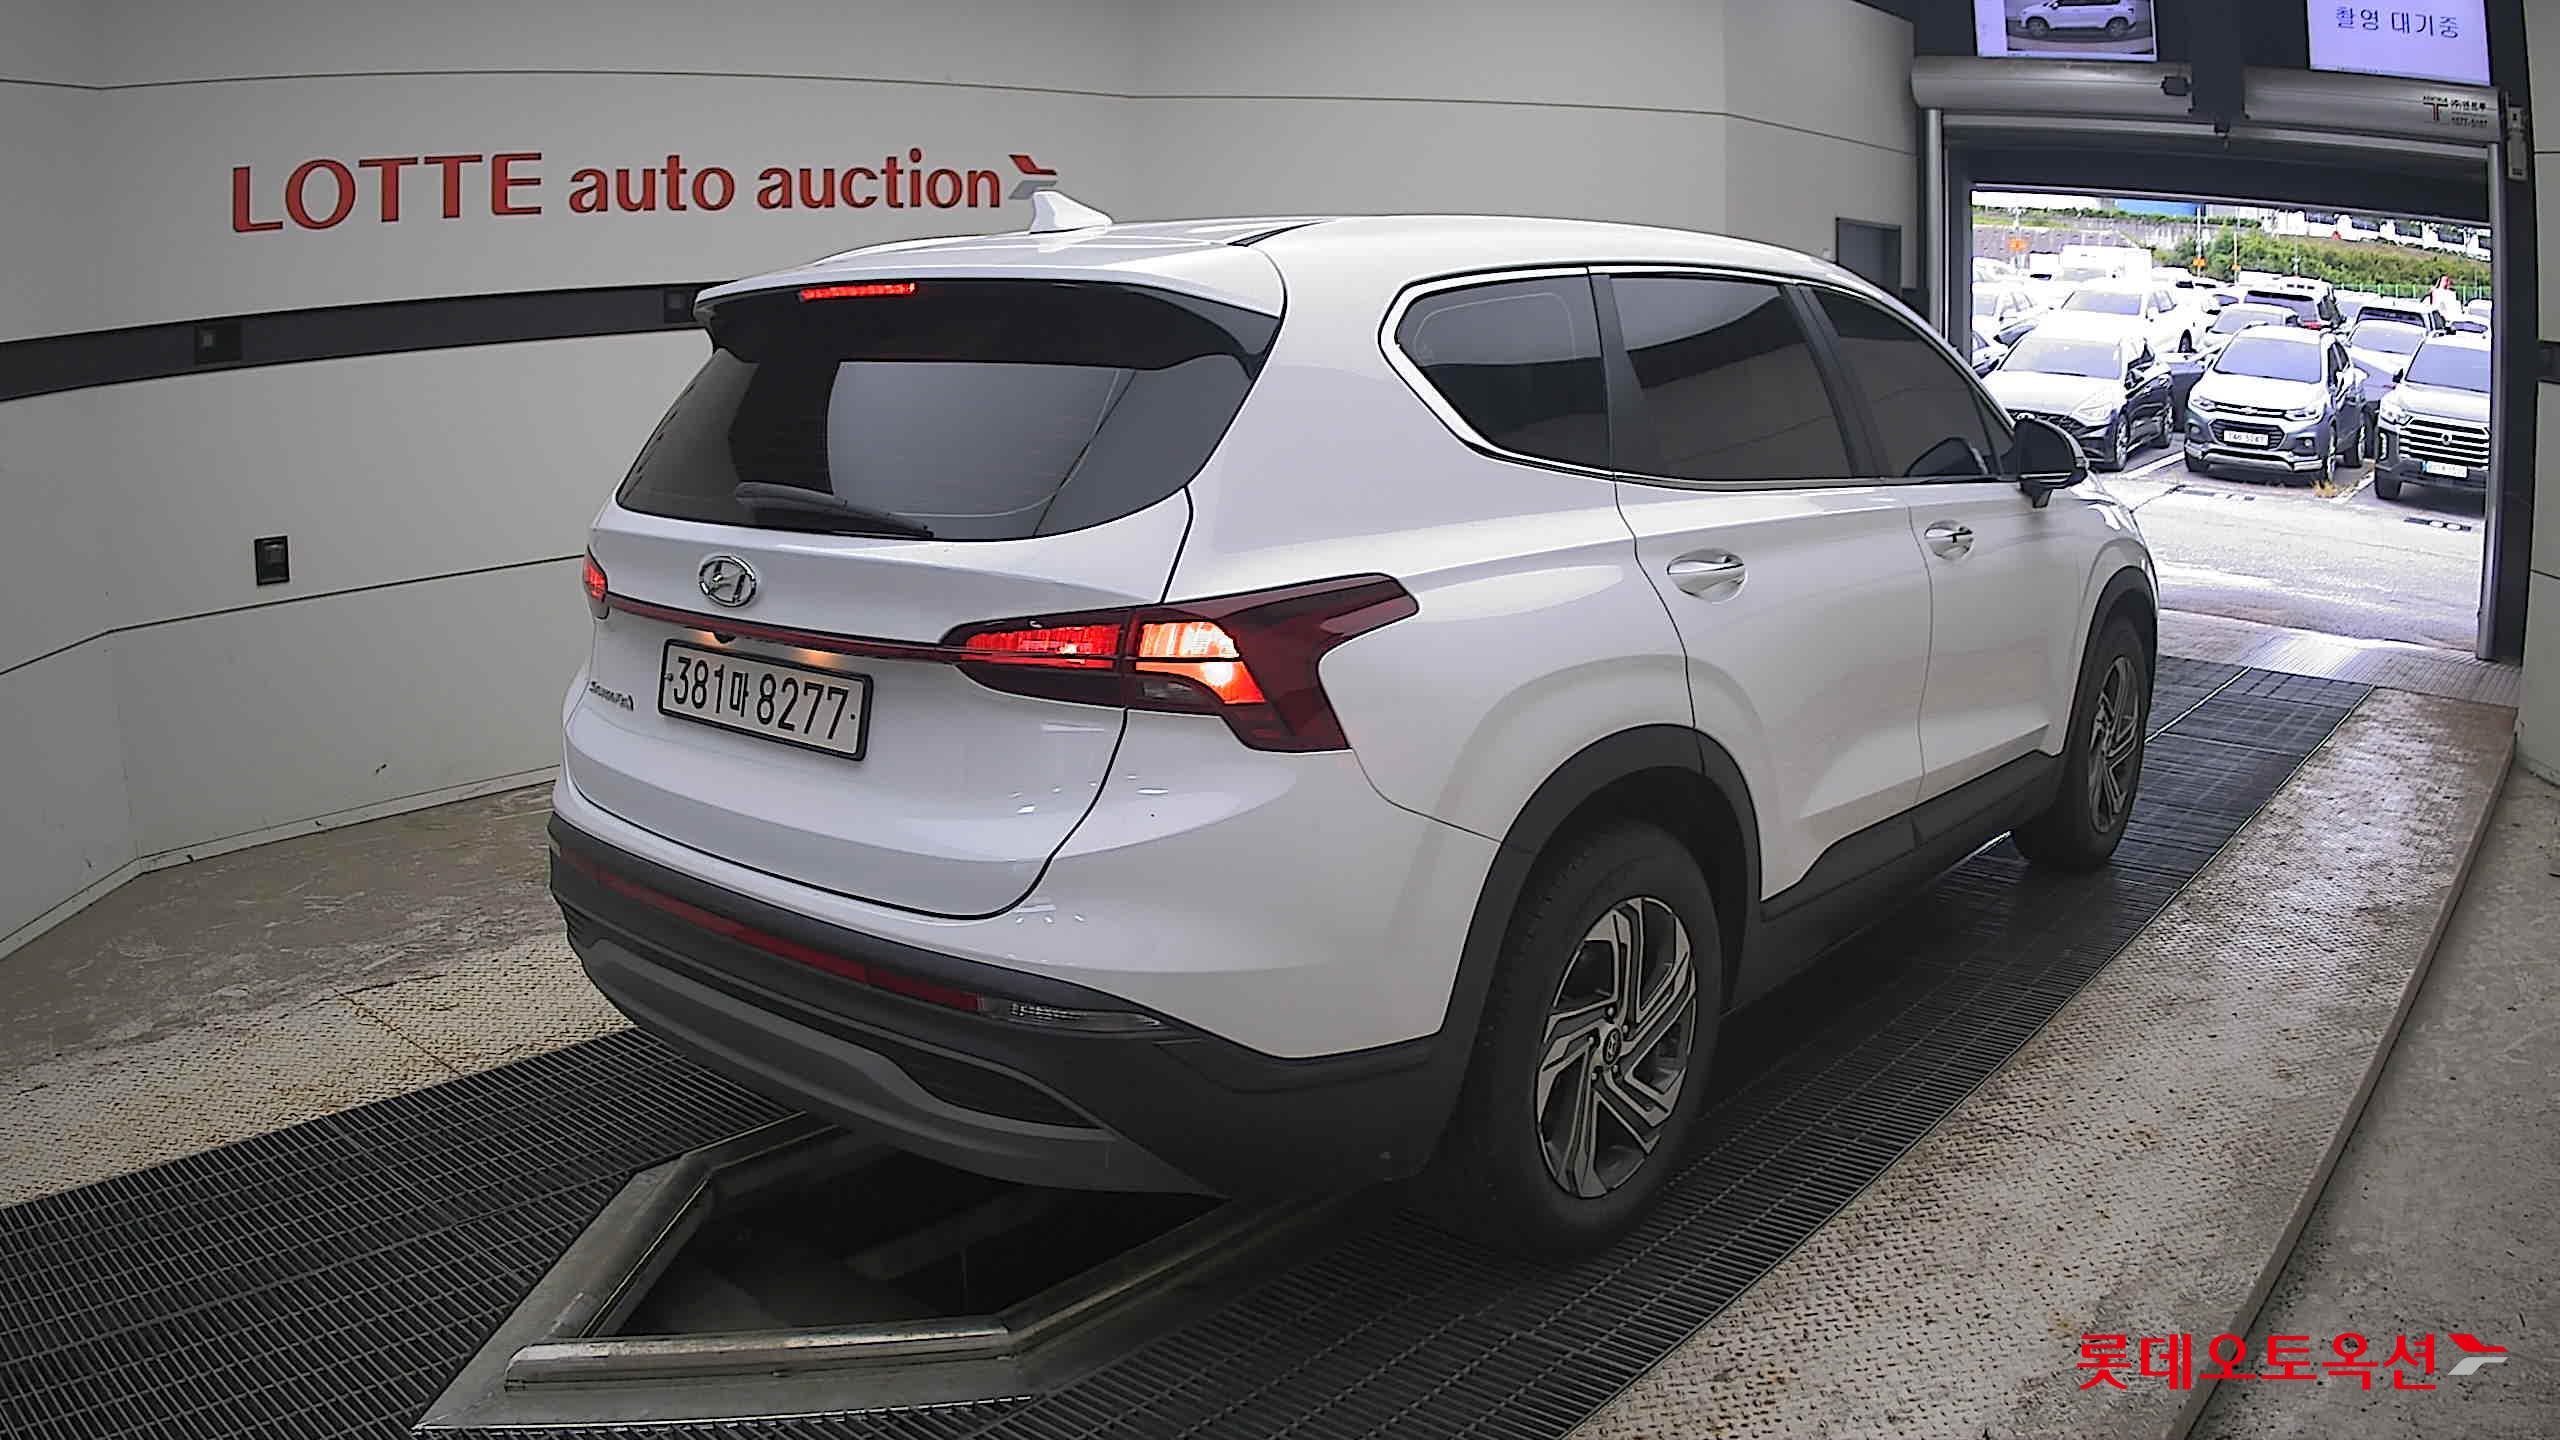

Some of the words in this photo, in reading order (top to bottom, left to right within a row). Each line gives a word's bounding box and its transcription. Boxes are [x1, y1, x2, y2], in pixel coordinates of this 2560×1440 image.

[2391, 11, 2459, 39] 대기중
[232, 151, 542, 233] LOTTE
[568, 153, 737, 215] auto
[756, 147, 1003, 210] auction
